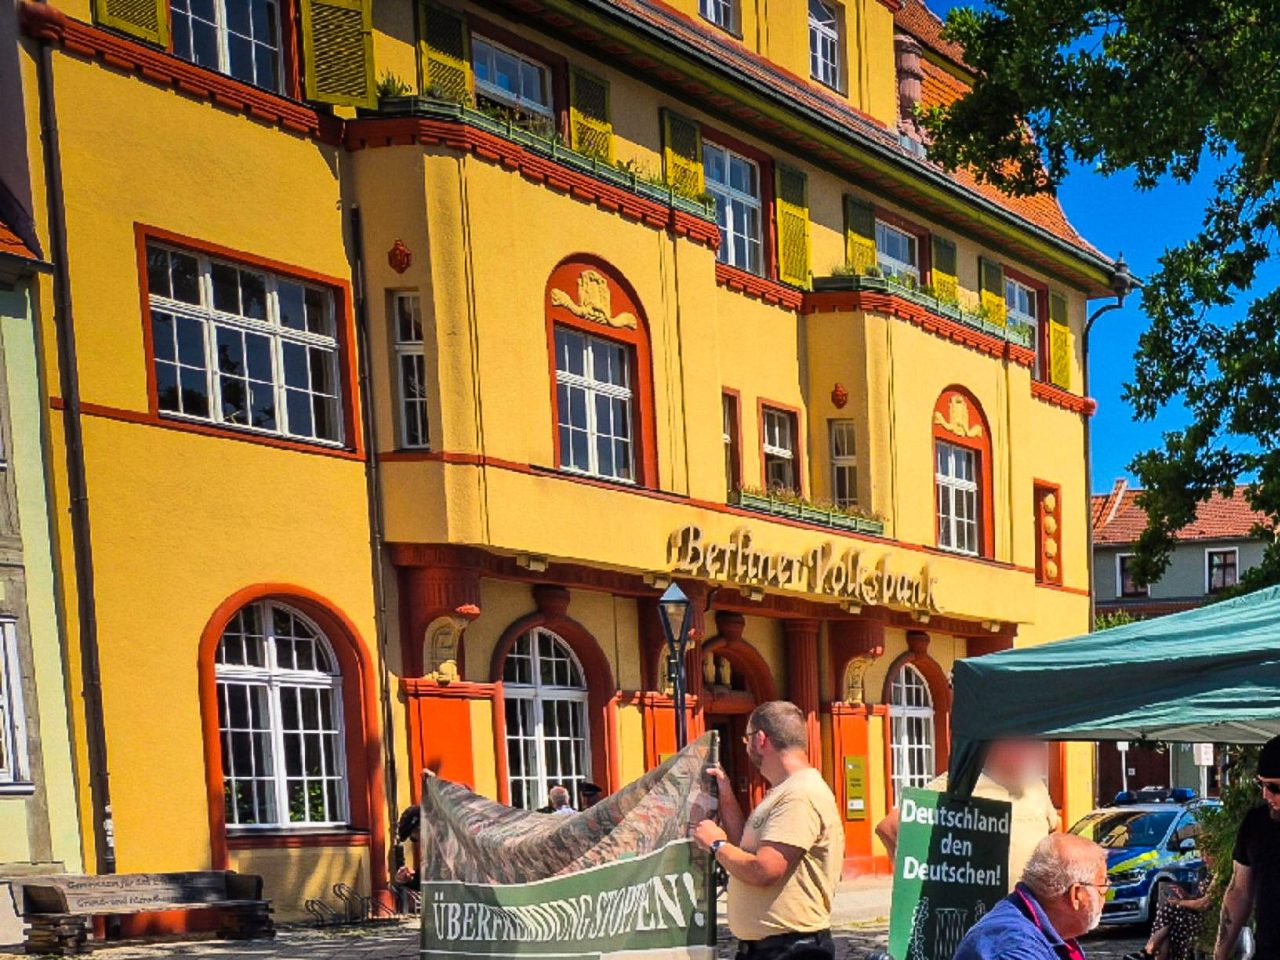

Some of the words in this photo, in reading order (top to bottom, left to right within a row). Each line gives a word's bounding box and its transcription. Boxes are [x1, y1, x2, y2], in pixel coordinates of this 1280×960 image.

[667, 526, 808, 590] Berliner
[808, 541, 945, 613] Volksbank
[901, 799, 1010, 834] Deutschland
[941, 833, 973, 856] den
[903, 856, 1001, 886] Deutschen!
